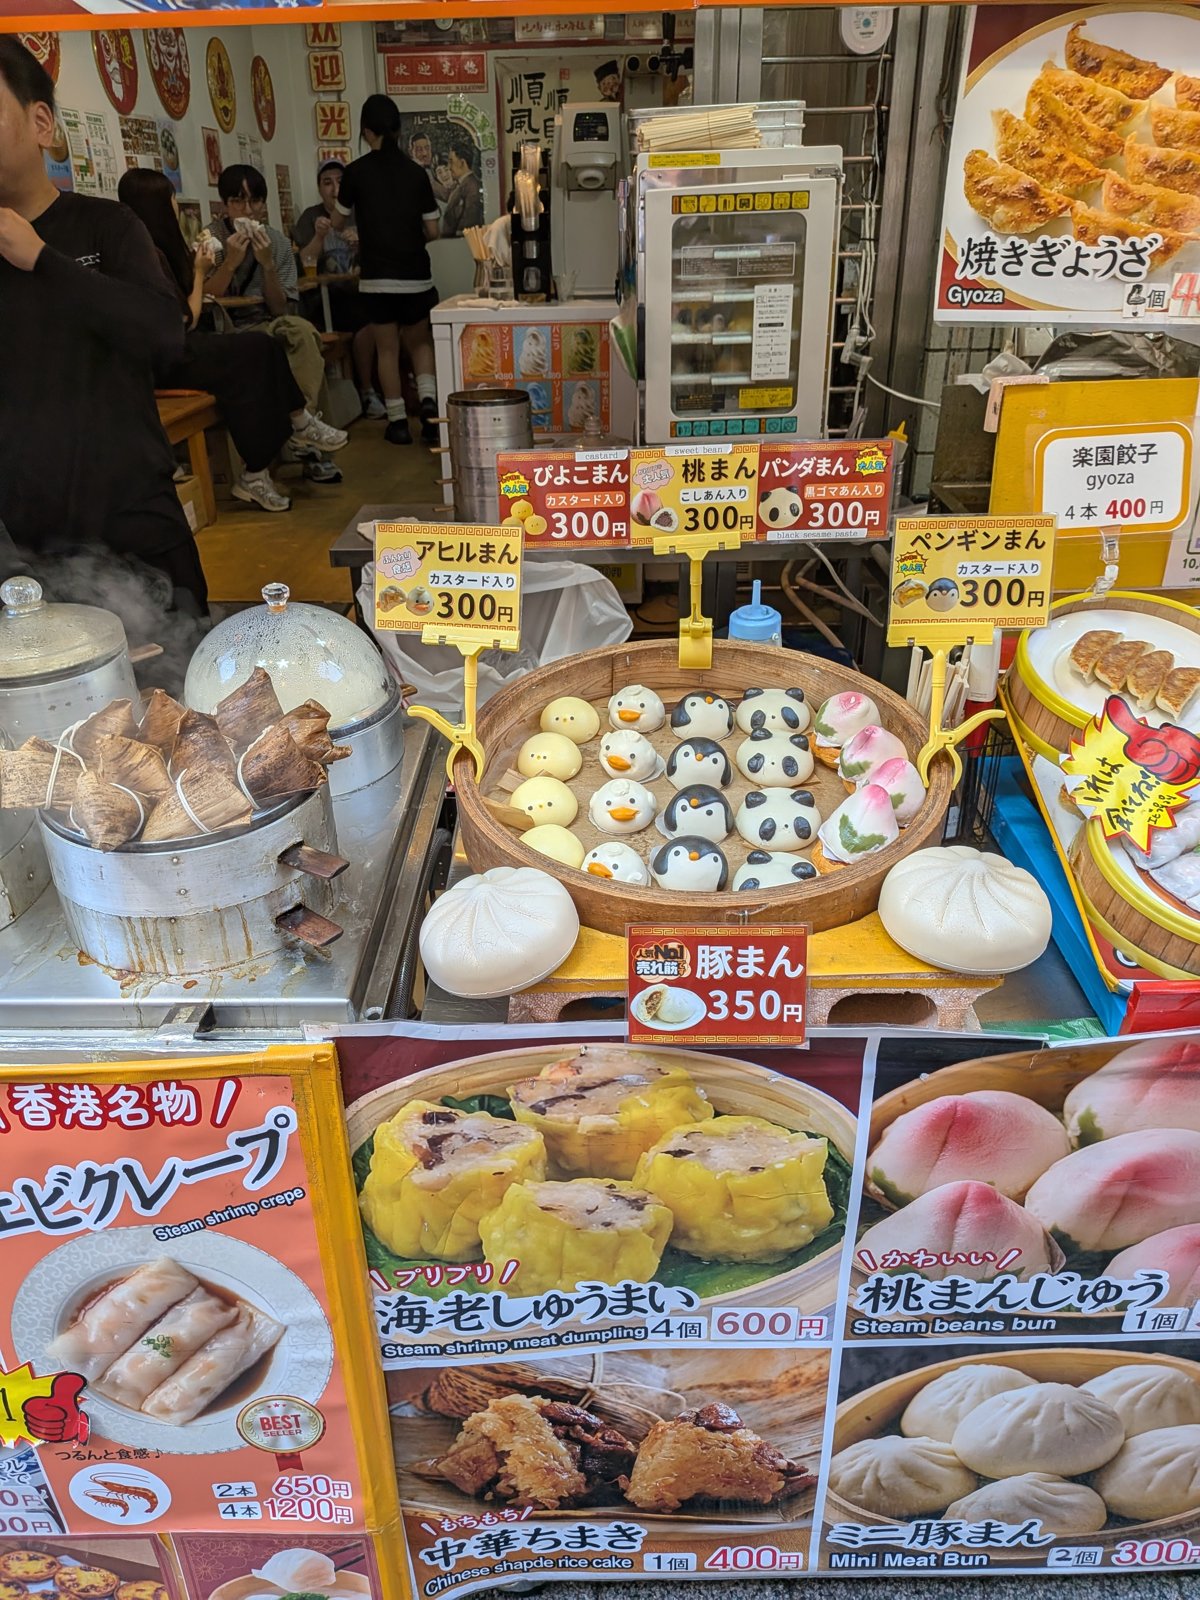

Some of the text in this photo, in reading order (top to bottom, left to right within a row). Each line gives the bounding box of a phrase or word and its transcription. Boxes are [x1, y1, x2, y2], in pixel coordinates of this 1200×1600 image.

[959, 236, 1159, 278] 焼きぎょうざ
[947, 286, 1005, 309] Gyoza
[584, 452, 618, 461] castard
[674, 445, 723, 455] sweet bean
[1072, 443, 1158, 468] 楽園餃子
[682, 457, 757, 484] 桃まん
[761, 457, 850, 478] パンダまん
[804, 484, 884, 498] 黒ゴマあん入り
[1086, 472, 1135, 490] gyoza
[546, 493, 624, 507] カスタード入り
[681, 489, 747, 503] こしあん入り
[684, 505, 754, 532] 300円
[808, 501, 880, 528] 300円
[1064, 498, 1164, 520] 4本 400円
[551, 511, 627, 539] 300円
[776, 531, 799, 539] black
[835, 530, 858, 539] paste
[910, 529, 1046, 551] ペンギンまん
[416, 540, 518, 565] アヒルまん
[429, 573, 515, 588] カスタード入り
[958, 563, 1040, 575] カスタード入り
[959, 578, 1045, 608] 300円
[437, 591, 513, 623] 300円
[695, 945, 804, 979] 豚まん
[707, 990, 802, 1023] 350円
[12, 1082, 198, 1127] 香港名物
[155, 1186, 305, 1241] Steam shrimp crepe
[882, 1249, 998, 1268] かわいい
[396, 1263, 493, 1287] プリプリ
[861, 1272, 1164, 1315] 桃まんじゅう
[375, 1283, 695, 1335] 海老しゅうまい
[1134, 1310, 1179, 1330] 1個
[650, 1311, 824, 1339] 4個 600円
[853, 1316, 1057, 1334] Steam beans bun
[384, 1326, 646, 1358] Steam shrimp meat dumpling
[259, 1414, 301, 1431] BEST
[262, 1429, 302, 1438] SELLER
[216, 1476, 350, 1498] 2本 650円
[221, 1498, 353, 1524] 4本 1200円
[440, 1508, 519, 1532] もちもち
[424, 1524, 643, 1568] 中華ちまき
[828, 1521, 1052, 1547] ミニ豚まん
[652, 1547, 800, 1571] 1個 400円
[830, 1551, 988, 1567] Mini Meat Bun
[1055, 1549, 1099, 1566] 2個
[424, 1556, 633, 1597] Chinese shapde rice cake
